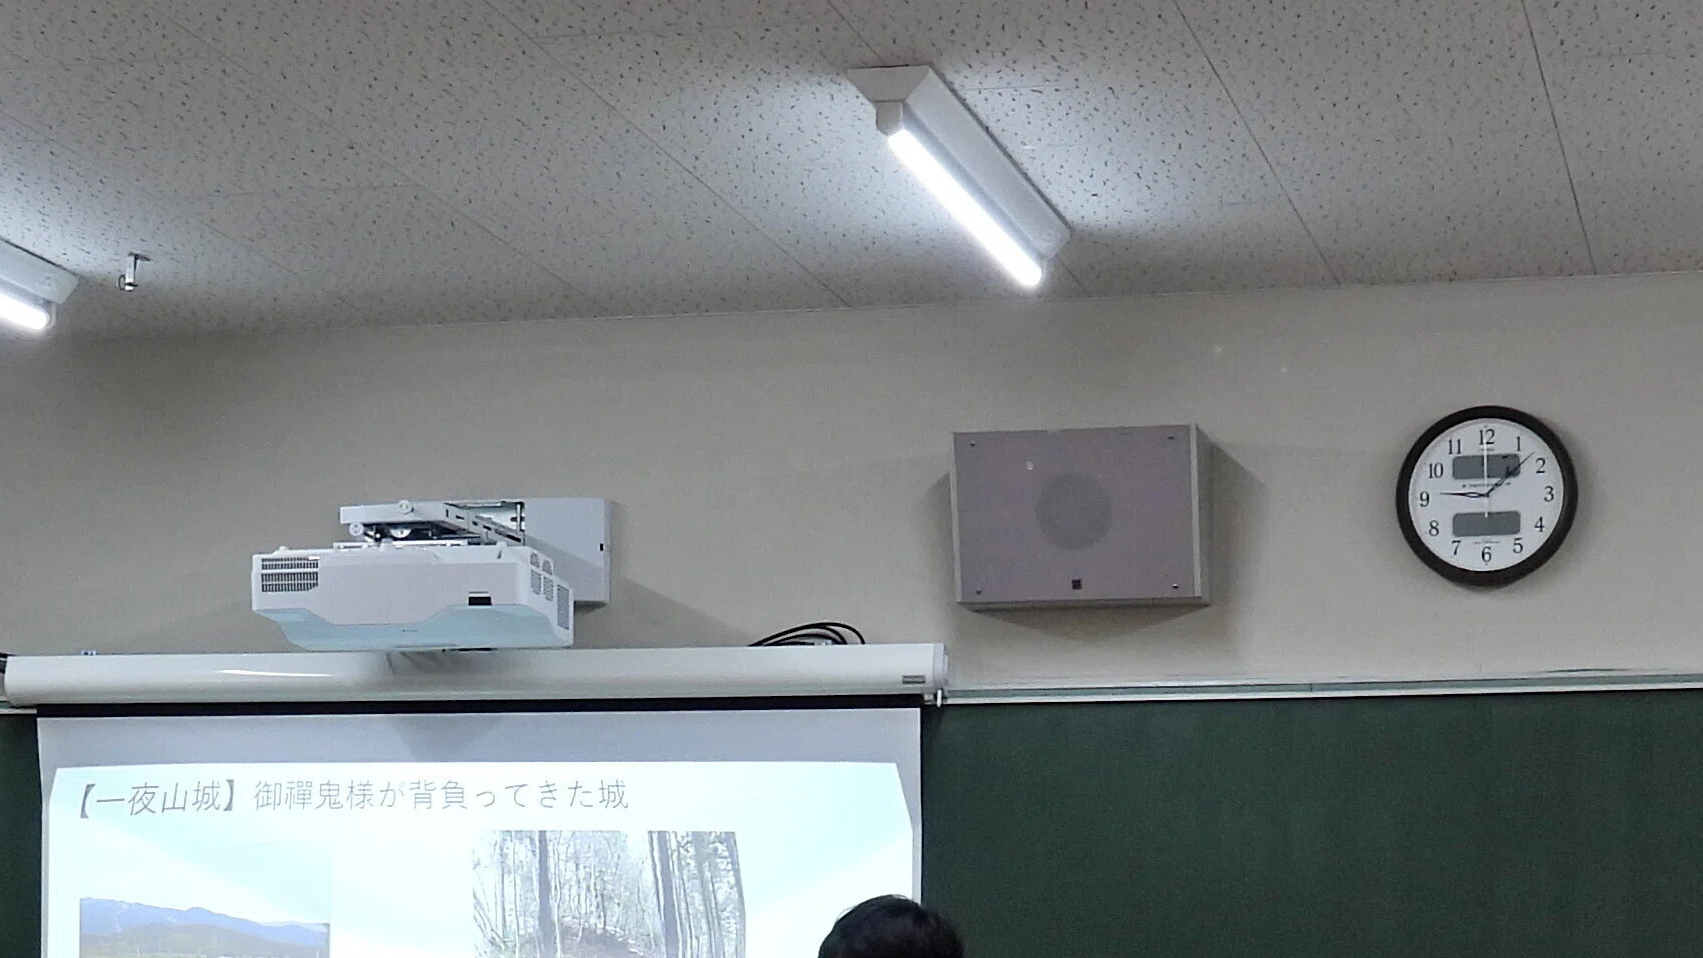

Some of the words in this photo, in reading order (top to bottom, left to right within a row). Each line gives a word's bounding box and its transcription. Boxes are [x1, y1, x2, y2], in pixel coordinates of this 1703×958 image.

[1479, 428, 1495, 446] 12
[1516, 435, 1521, 452] 1
[1448, 438, 1461, 455] 11
[1428, 462, 1444, 479] 10
[1535, 457, 1546, 474] 2
[1419, 490, 1430, 508] 9
[1544, 485, 1554, 502] 3
[1428, 519, 1440, 537] 8
[1534, 516, 1545, 533] 4
[1451, 539, 1461, 556] 7
[1512, 537, 1524, 554] 5
[1481, 546, 1492, 563] 6
